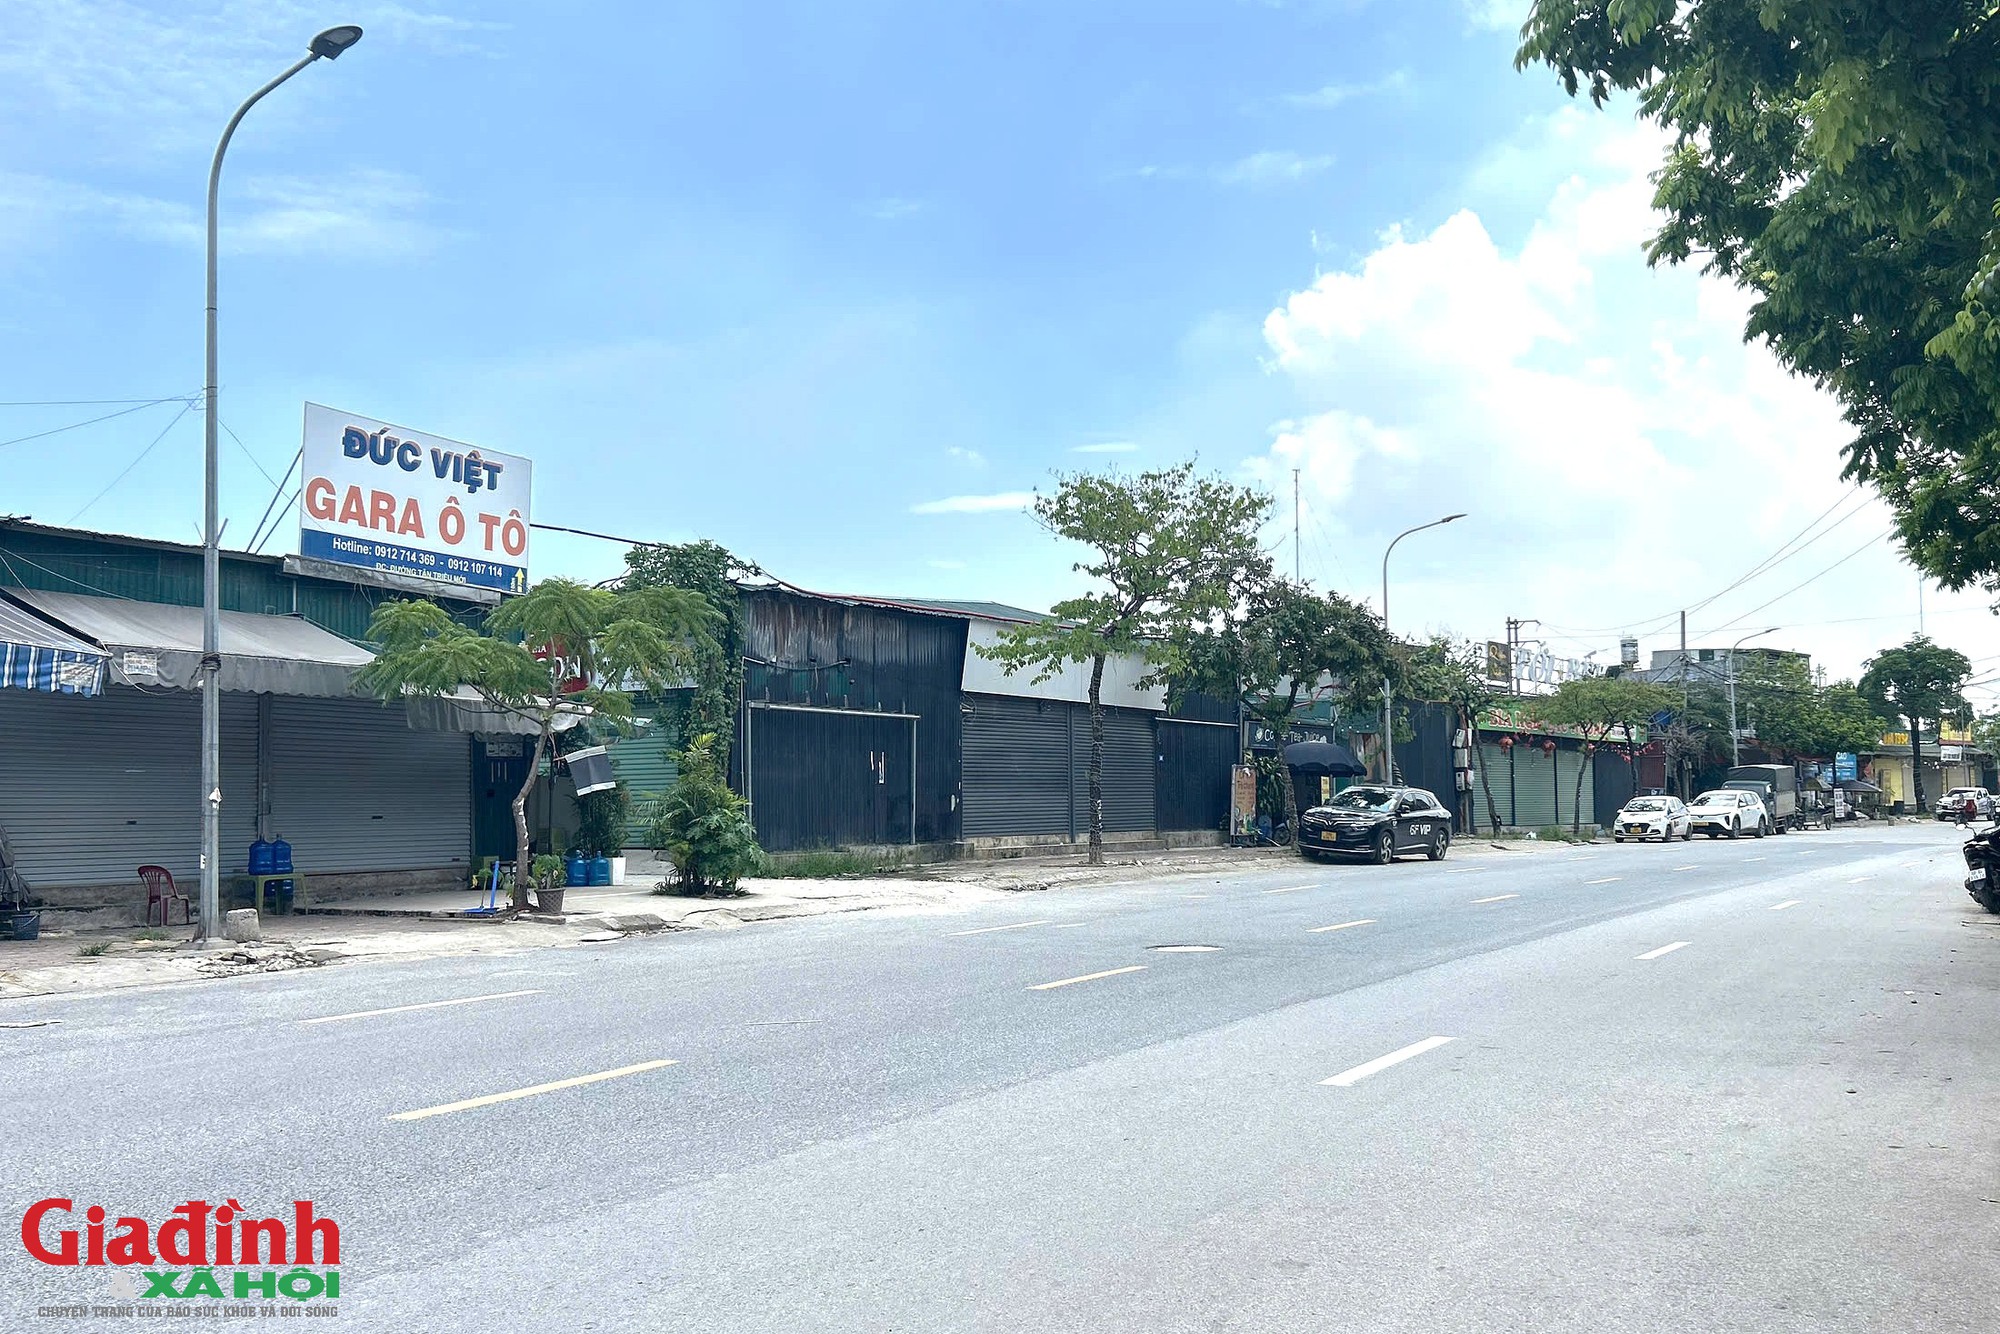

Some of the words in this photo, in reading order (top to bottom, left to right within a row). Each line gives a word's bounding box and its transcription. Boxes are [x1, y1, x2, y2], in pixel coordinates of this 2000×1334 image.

[342, 426, 422, 472] ĐỨC
[430, 448, 503, 493] VIỆT
[305, 477, 425, 539] GARA
[438, 496, 466, 545] Ô
[478, 509, 526, 557] TÔ
[333, 537, 372, 556] Hotline:
[375, 546, 398, 560] 0912
[400, 550, 417, 563] 714
[419, 553, 436, 566] 369
[448, 558, 469, 572] 0912
[471, 562, 487, 575] 107
[488, 565, 503, 577] 114
